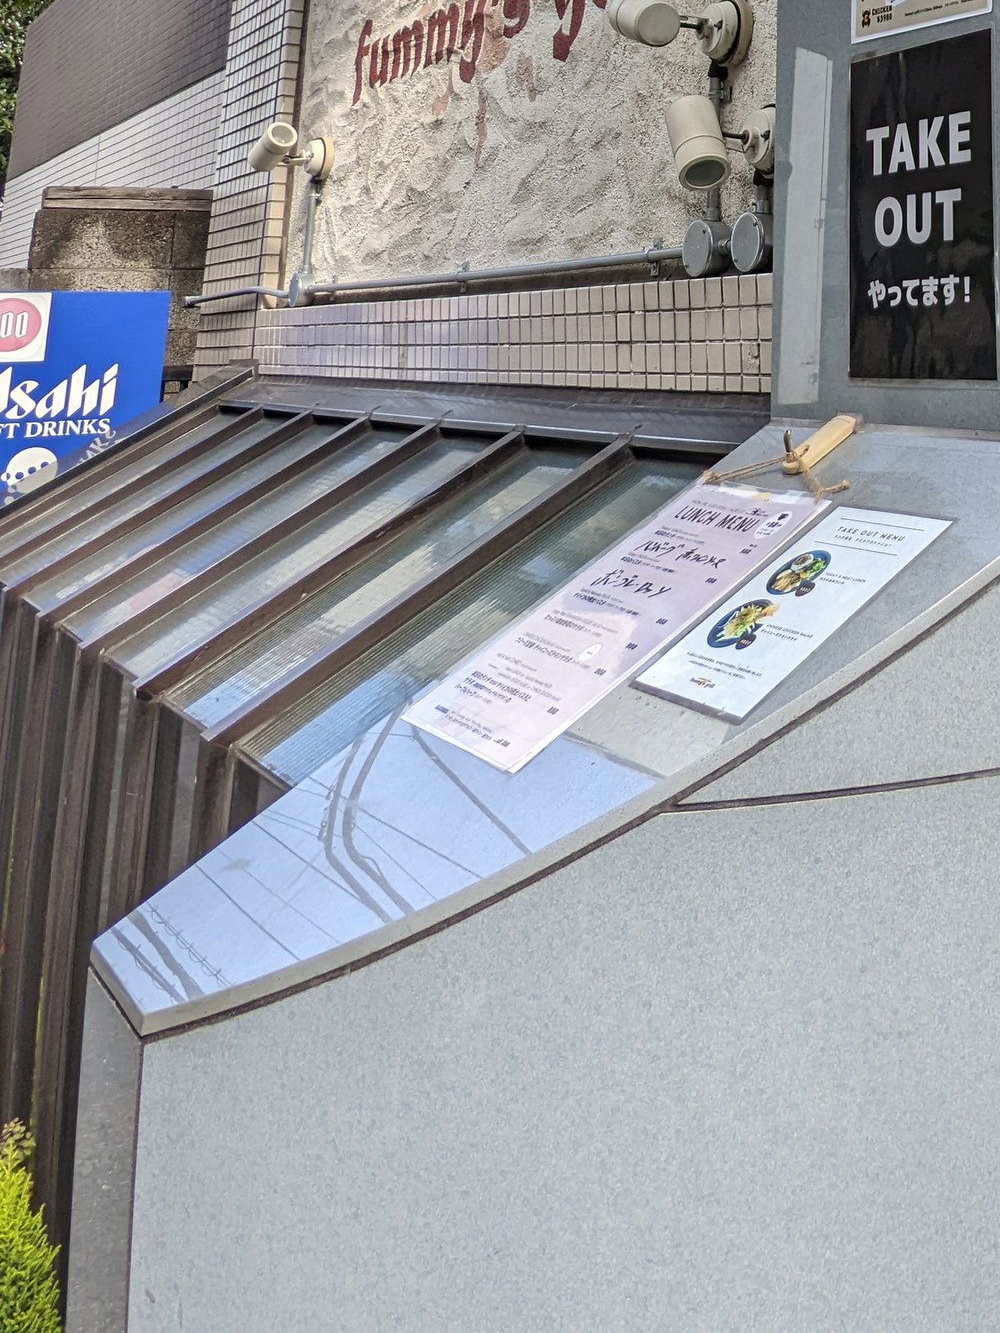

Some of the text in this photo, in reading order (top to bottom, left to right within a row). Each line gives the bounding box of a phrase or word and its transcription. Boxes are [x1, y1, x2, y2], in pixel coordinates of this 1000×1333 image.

[866, 110, 971, 176] TAKE
[874, 187, 962, 247] OUT
[24, 418, 111, 438] DRINKS
[674, 505, 722, 525] LUNCH
[715, 514, 760, 533] MENU
[837, 526, 859, 534] TAKE
[880, 533, 905, 542] MENU
